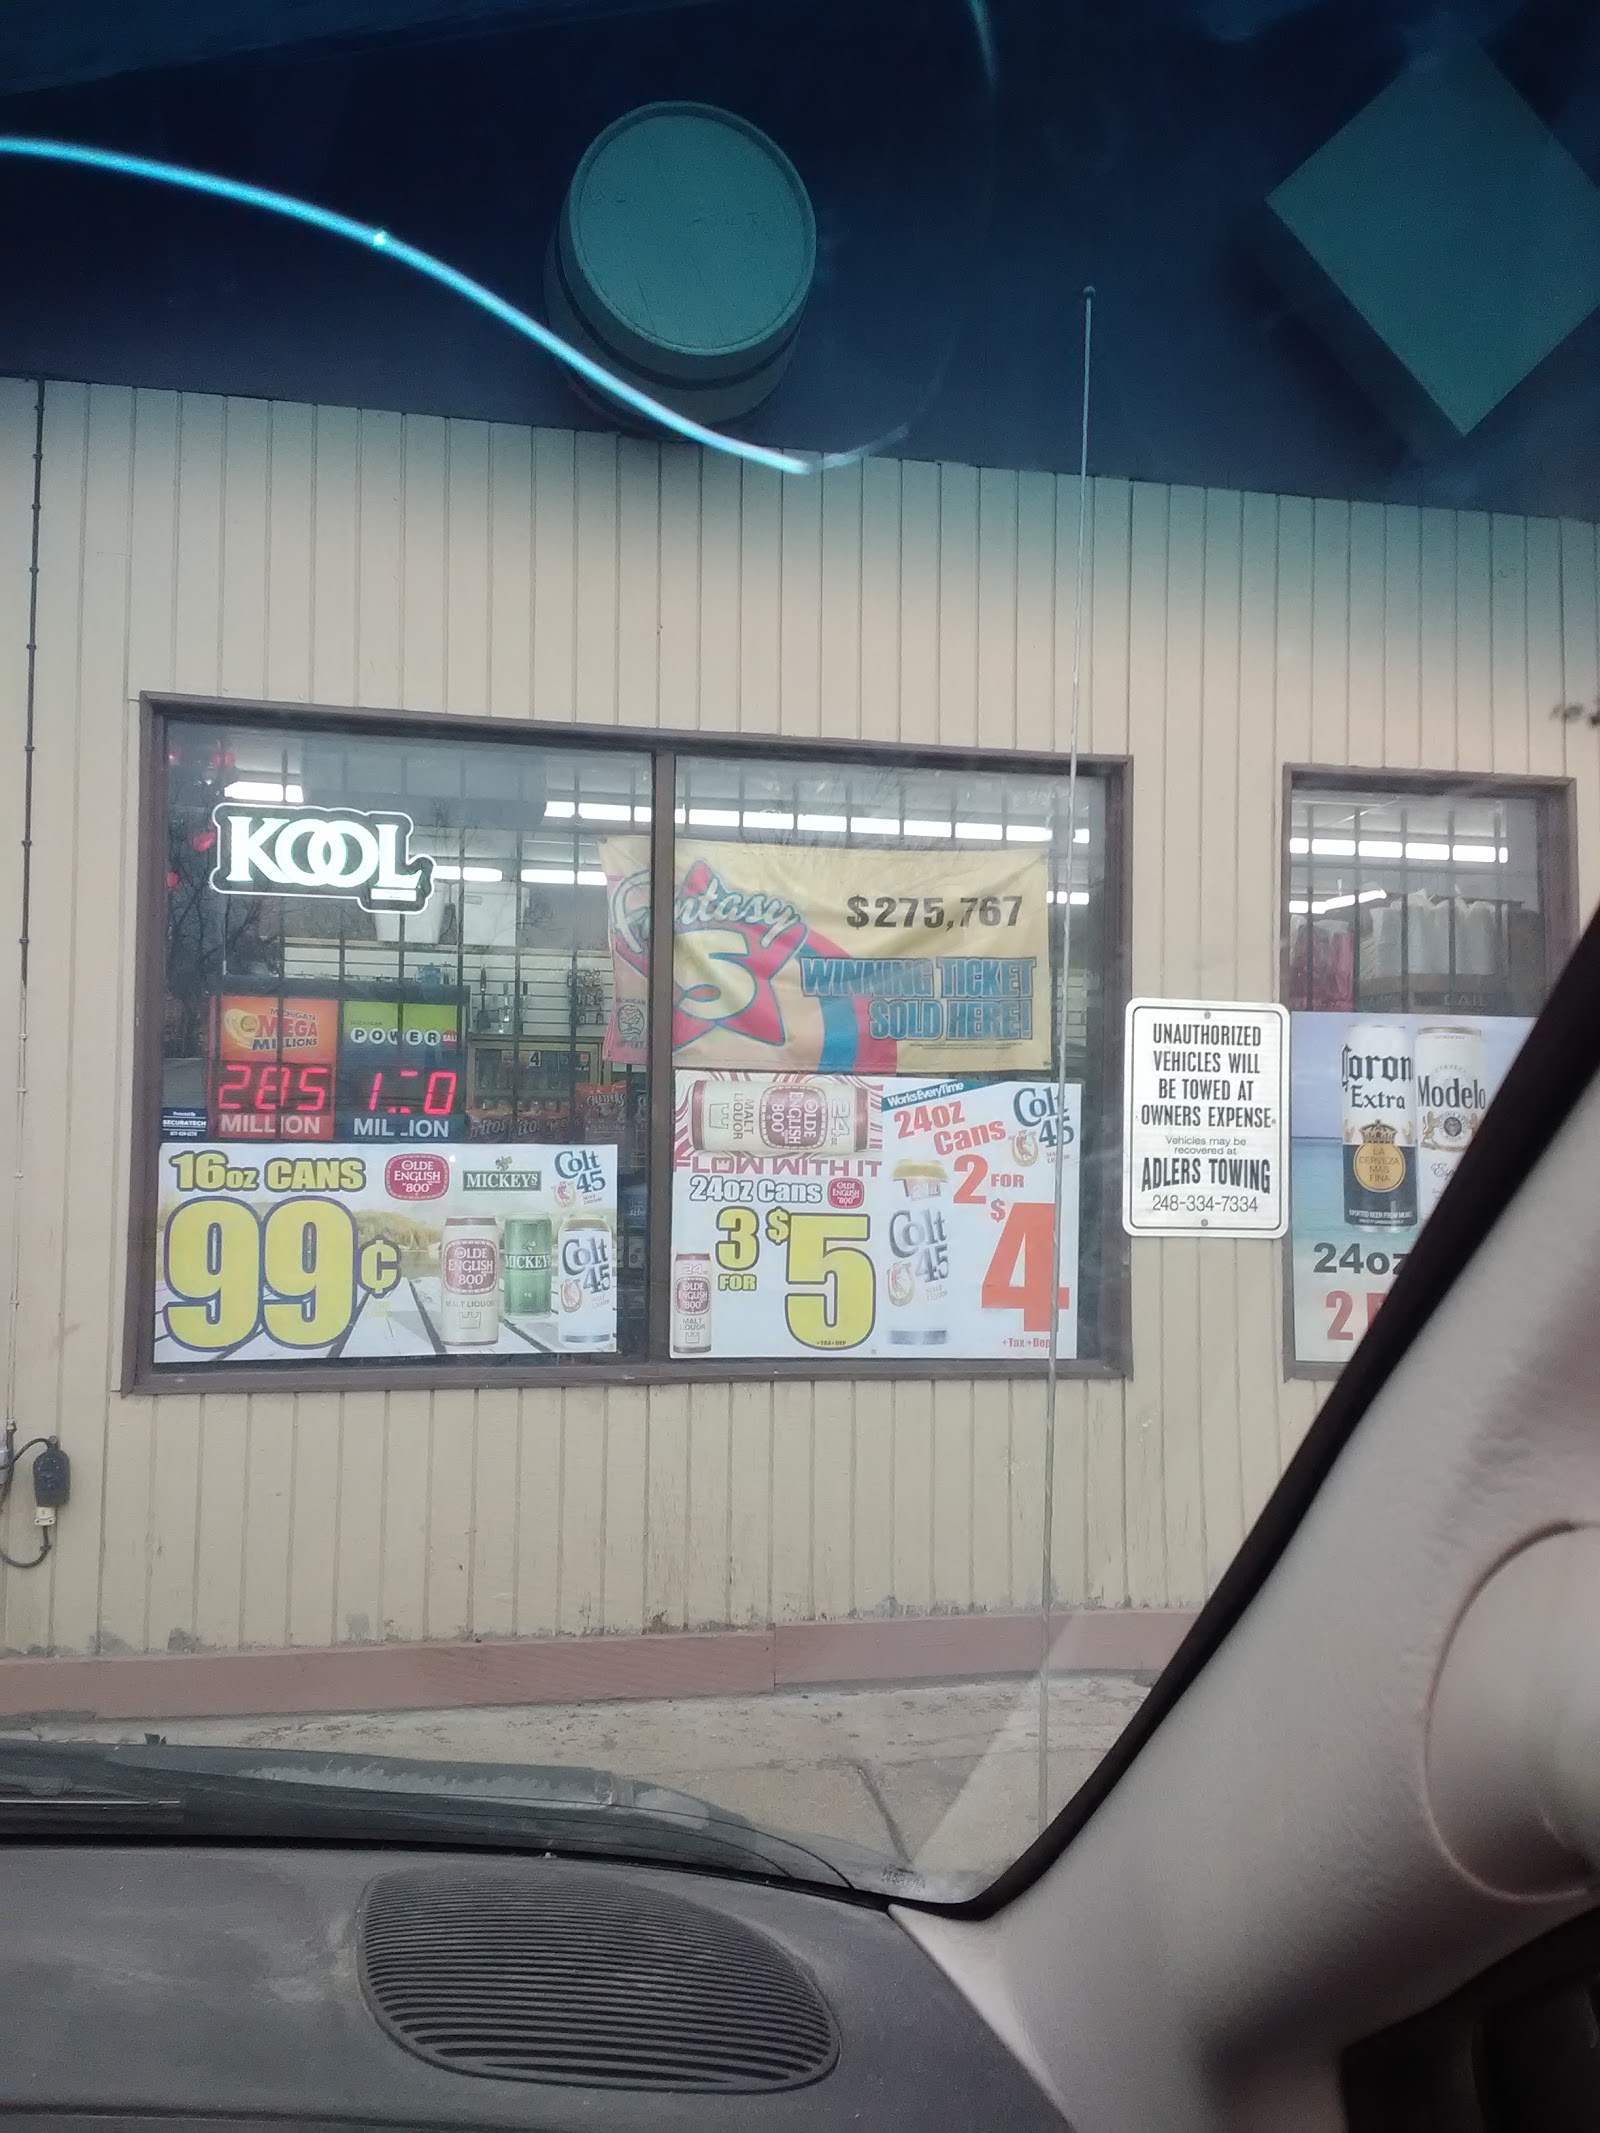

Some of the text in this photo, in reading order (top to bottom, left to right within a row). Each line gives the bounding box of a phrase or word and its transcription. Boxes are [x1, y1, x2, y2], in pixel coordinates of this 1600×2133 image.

[226, 815, 423, 889] KOOL
[612, 868, 801, 953] Fntasy
[846, 895, 1023, 933] $275,767
[673, 929, 757, 1021] 5
[800, 957, 1037, 999] WINNING TICKET
[257, 1014, 318, 1038] MEGA
[270, 1007, 316, 1020] MCHIGAN
[869, 999, 1033, 1040] SOLD HERE!
[252, 1035, 318, 1051] MILIONS
[1152, 1023, 1262, 1046] UNAUTHORIZED
[1153, 1050, 1261, 1074] VEHICLES WILL
[1158, 1078, 1254, 1101] BE TOWED AT
[1351, 1084, 1406, 1110] Extra
[1417, 1075, 1486, 1110] Modelo
[220, 1114, 321, 1134] MILLION
[353, 1118, 449, 1138] MILION
[733, 1092, 744, 1140] LIQUOR
[743, 1098, 754, 1135] MALT
[786, 1091, 804, 1144] ENGLISH
[803, 1100, 818, 1138] OLDE
[831, 1100, 850, 1138] 24
[894, 1100, 965, 1139] 24oz
[1141, 1104, 1201, 1127] OWNERS
[933, 1120, 1008, 1156] Cans
[1038, 1115, 1075, 1148] 45
[1165, 1135, 1247, 1147] Vehicles may be
[1174, 1146, 1237, 1156] recovered at
[1359, 1156, 1400, 1165] CERVEZA
[1372, 1148, 1385, 1156] LA
[169, 1149, 368, 1193] 16oz CANS
[394, 1170, 441, 1183] ENGLISH
[401, 1160, 434, 1171] OLDE
[554, 1150, 601, 1180] Colt
[673, 1156, 882, 1177] FLOW WITH IT
[1141, 1157, 1271, 1194] ADLERS TOWING
[576, 1169, 606, 1194] 45
[690, 1175, 823, 1203] 24oz Cans
[836, 1182, 856, 1190] OLDE
[953, 1154, 989, 1204] 2
[991, 1173, 1025, 1188] FOR
[832, 1189, 860, 1198] ENGLISH
[1152, 1194, 1258, 1213] 248-334-7334
[715, 1206, 760, 1271] 3
[889, 1208, 947, 1258] Colt
[448, 1259, 494, 1272] ENGLISH
[454, 1247, 488, 1259] OLDE
[562, 1236, 609, 1276] Colt
[914, 1244, 949, 1283] 45
[583, 1263, 611, 1294] 45
[682, 1282, 705, 1290] OLDE
[718, 1273, 757, 1292] FOR
[678, 1290, 708, 1300] ENGLISH
[1325, 1290, 1354, 1341] 2
